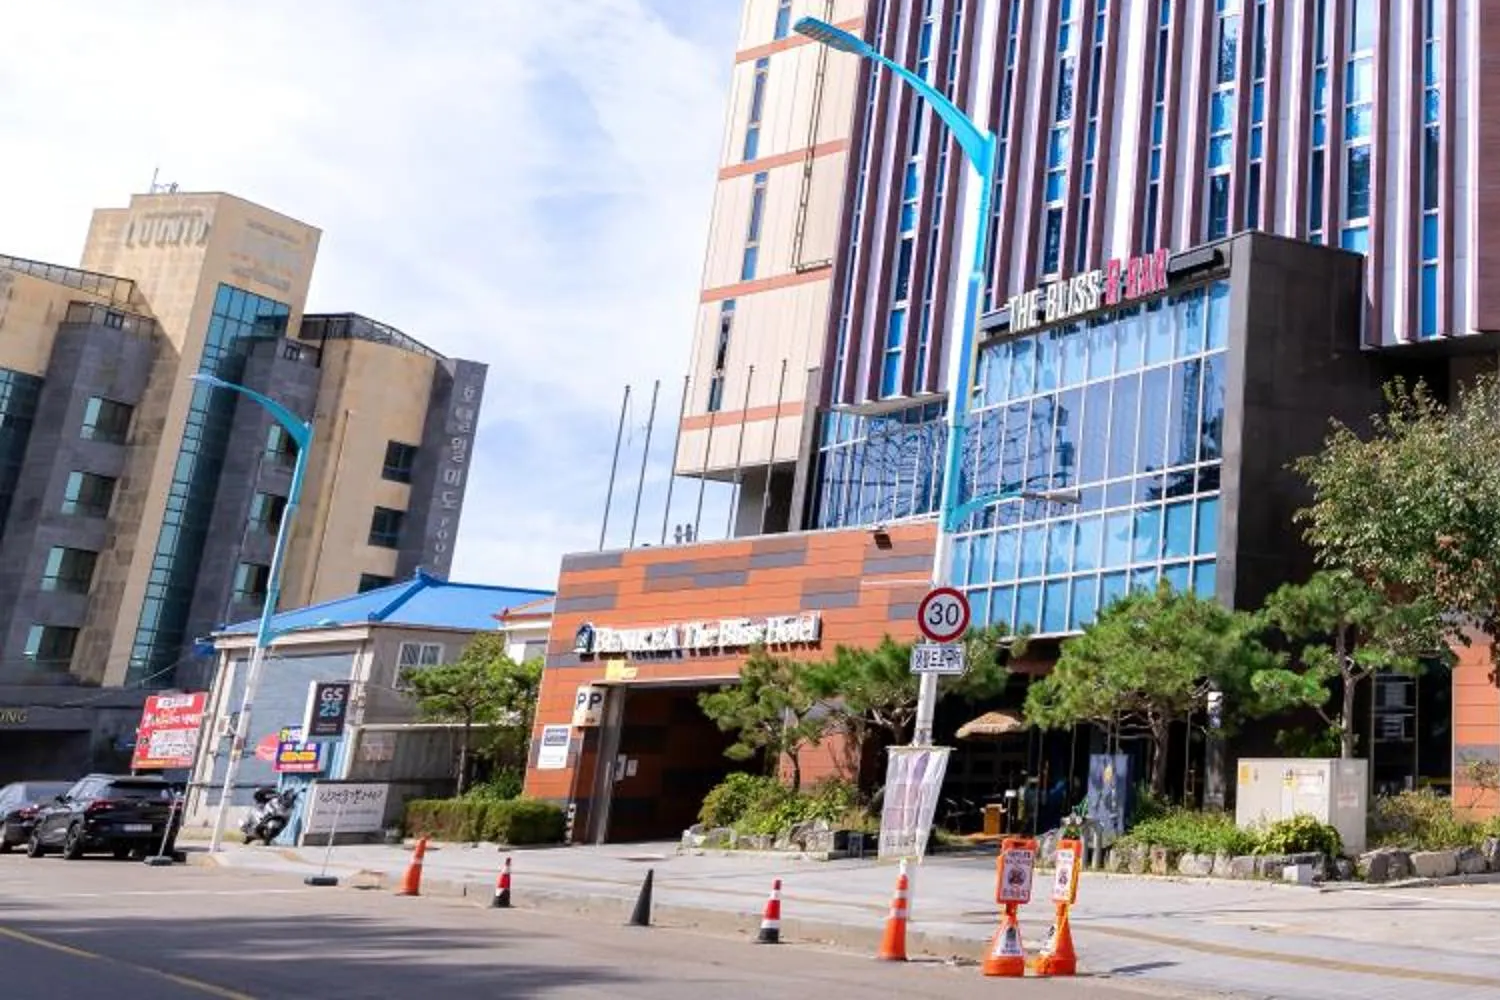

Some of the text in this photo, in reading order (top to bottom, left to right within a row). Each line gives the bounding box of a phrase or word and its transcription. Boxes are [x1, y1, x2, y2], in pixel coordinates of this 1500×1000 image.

[1007, 289, 1042, 334] THE
[1044, 269, 1103, 323] BLISS
[928, 602, 960, 626] 30
[321, 687, 344, 701] GS
[588, 692, 602, 710] P
[319, 702, 341, 717] 25
